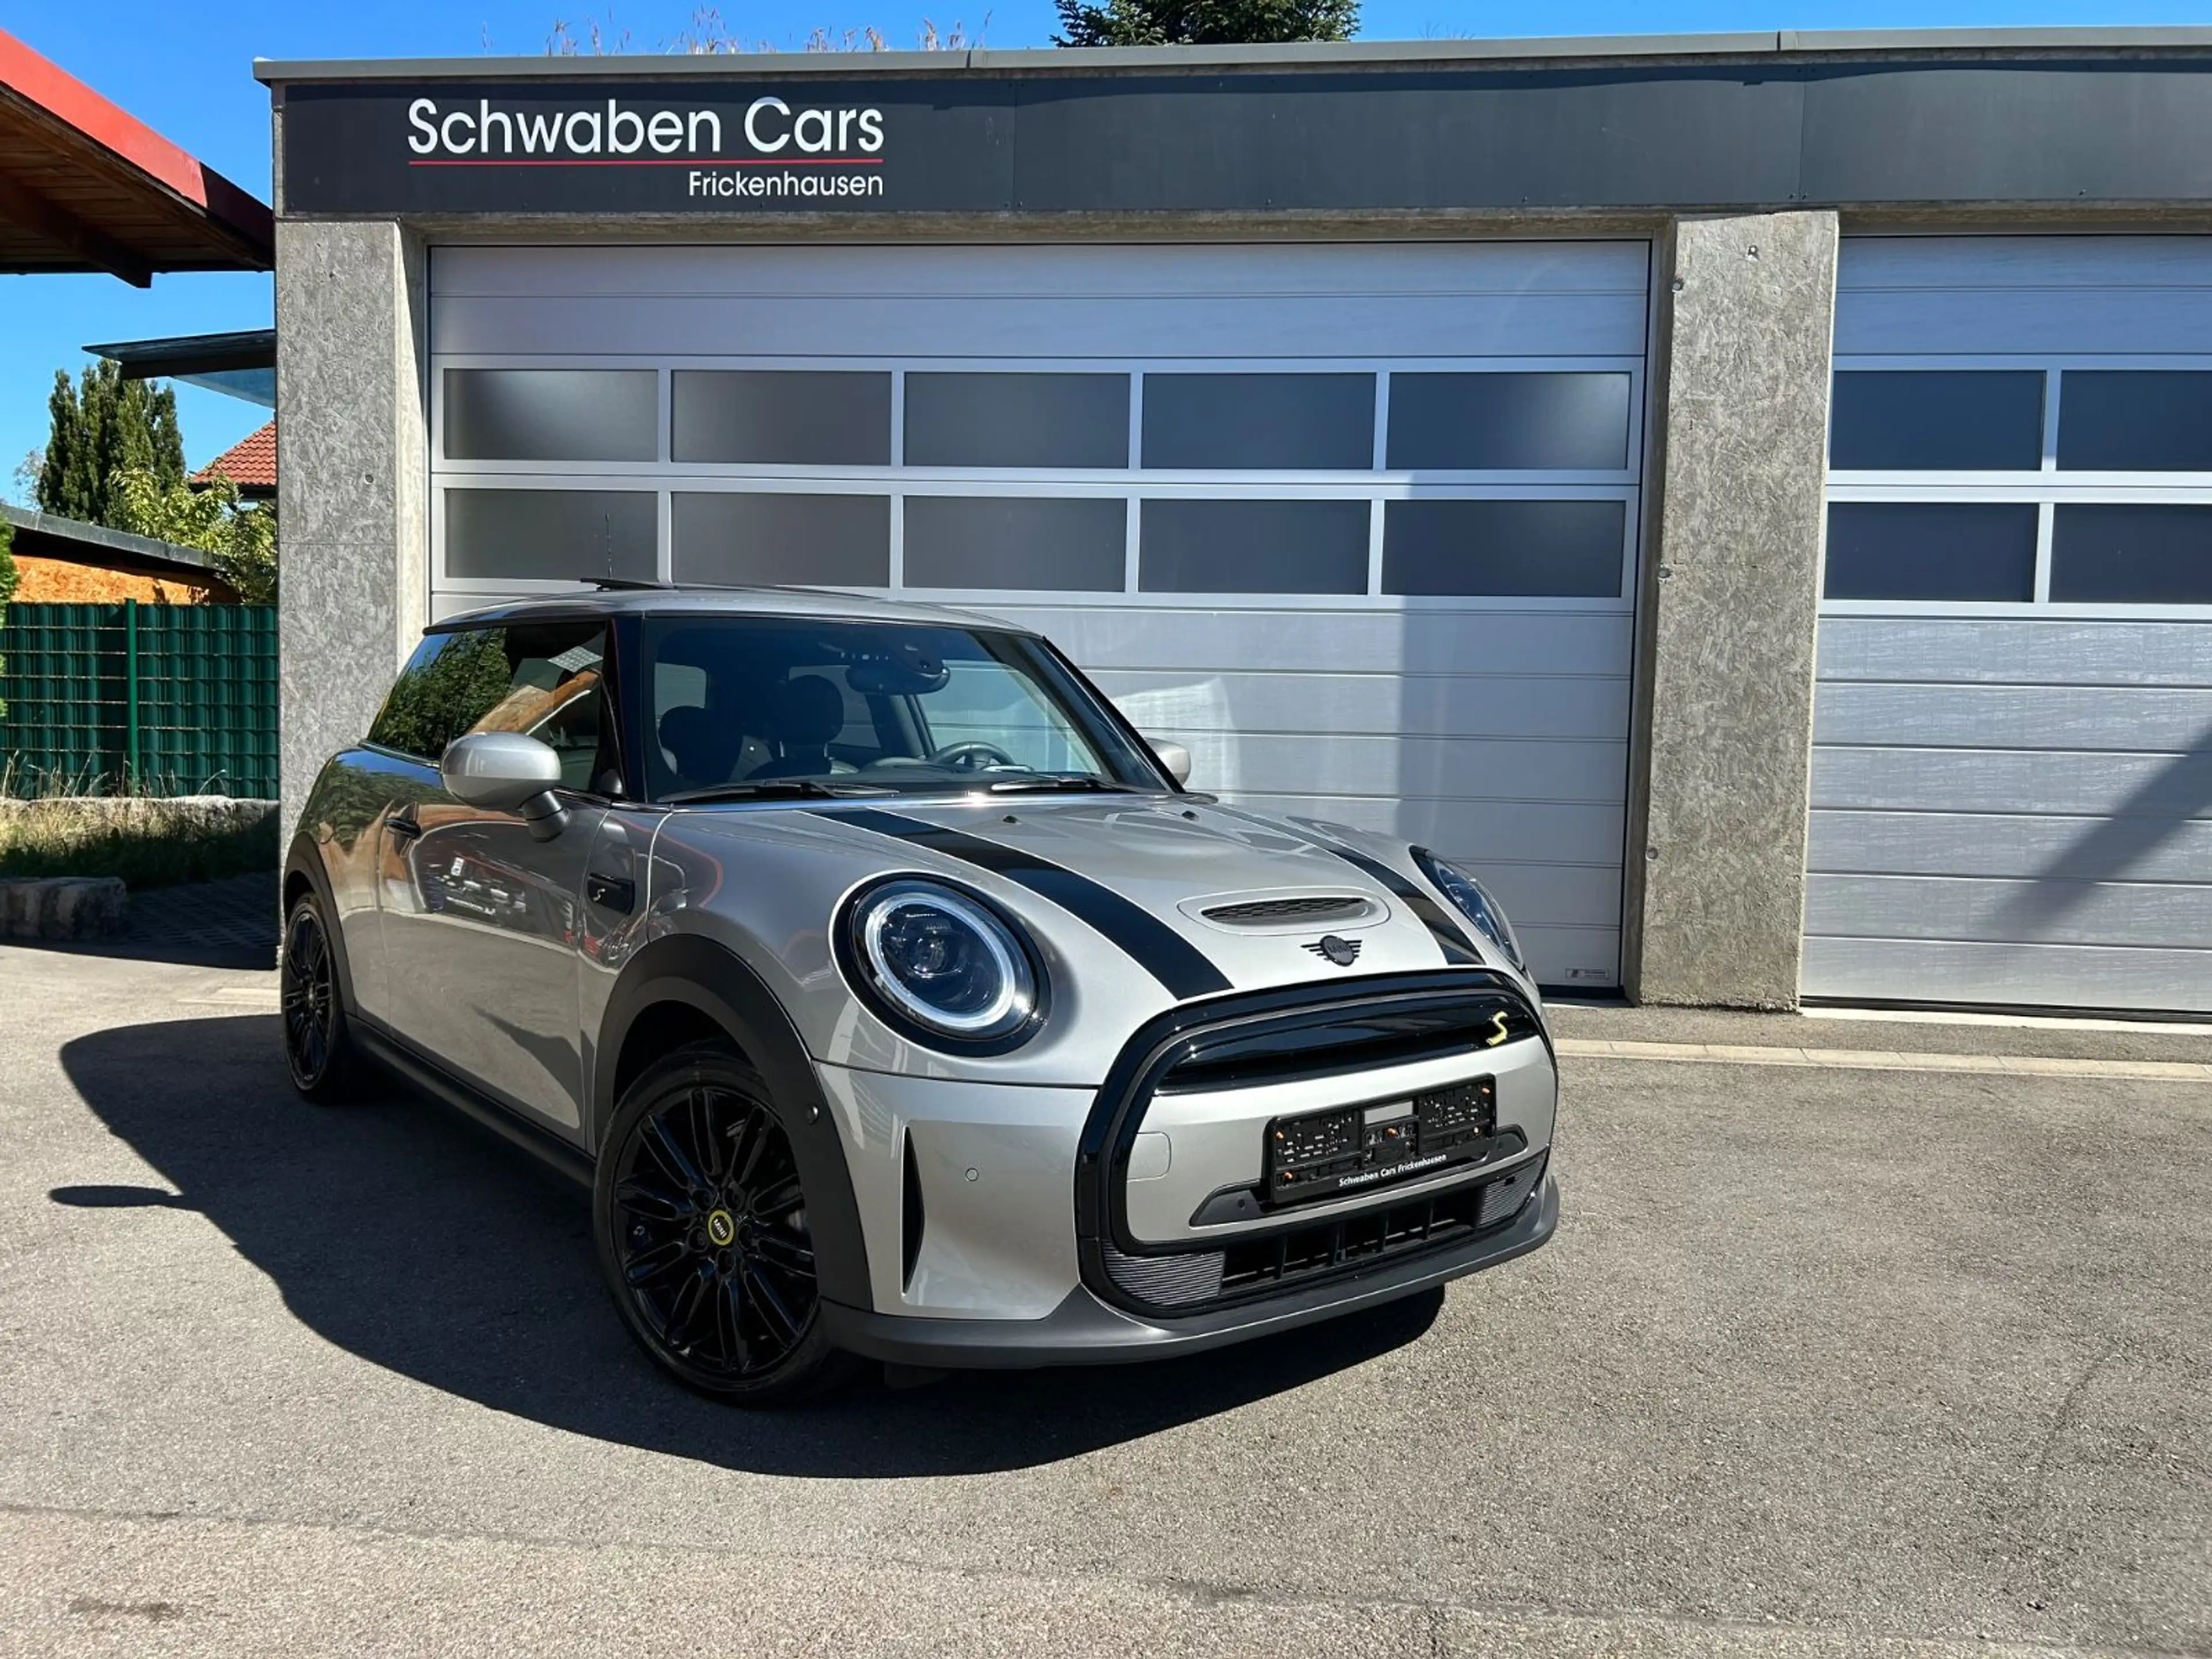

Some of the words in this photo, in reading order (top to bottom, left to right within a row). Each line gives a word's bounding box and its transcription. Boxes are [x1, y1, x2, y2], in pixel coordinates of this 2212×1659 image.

[408, 98, 721, 154] Schwaben
[744, 97, 884, 153] Cars
[689, 171, 883, 196] Frickenhausen
[1486, 1011, 1508, 1046] S
[1339, 1172, 1378, 1187] Schwaben
[1380, 1165, 1396, 1177] Cars
[1397, 1154, 1447, 1173] Frickenhausen
